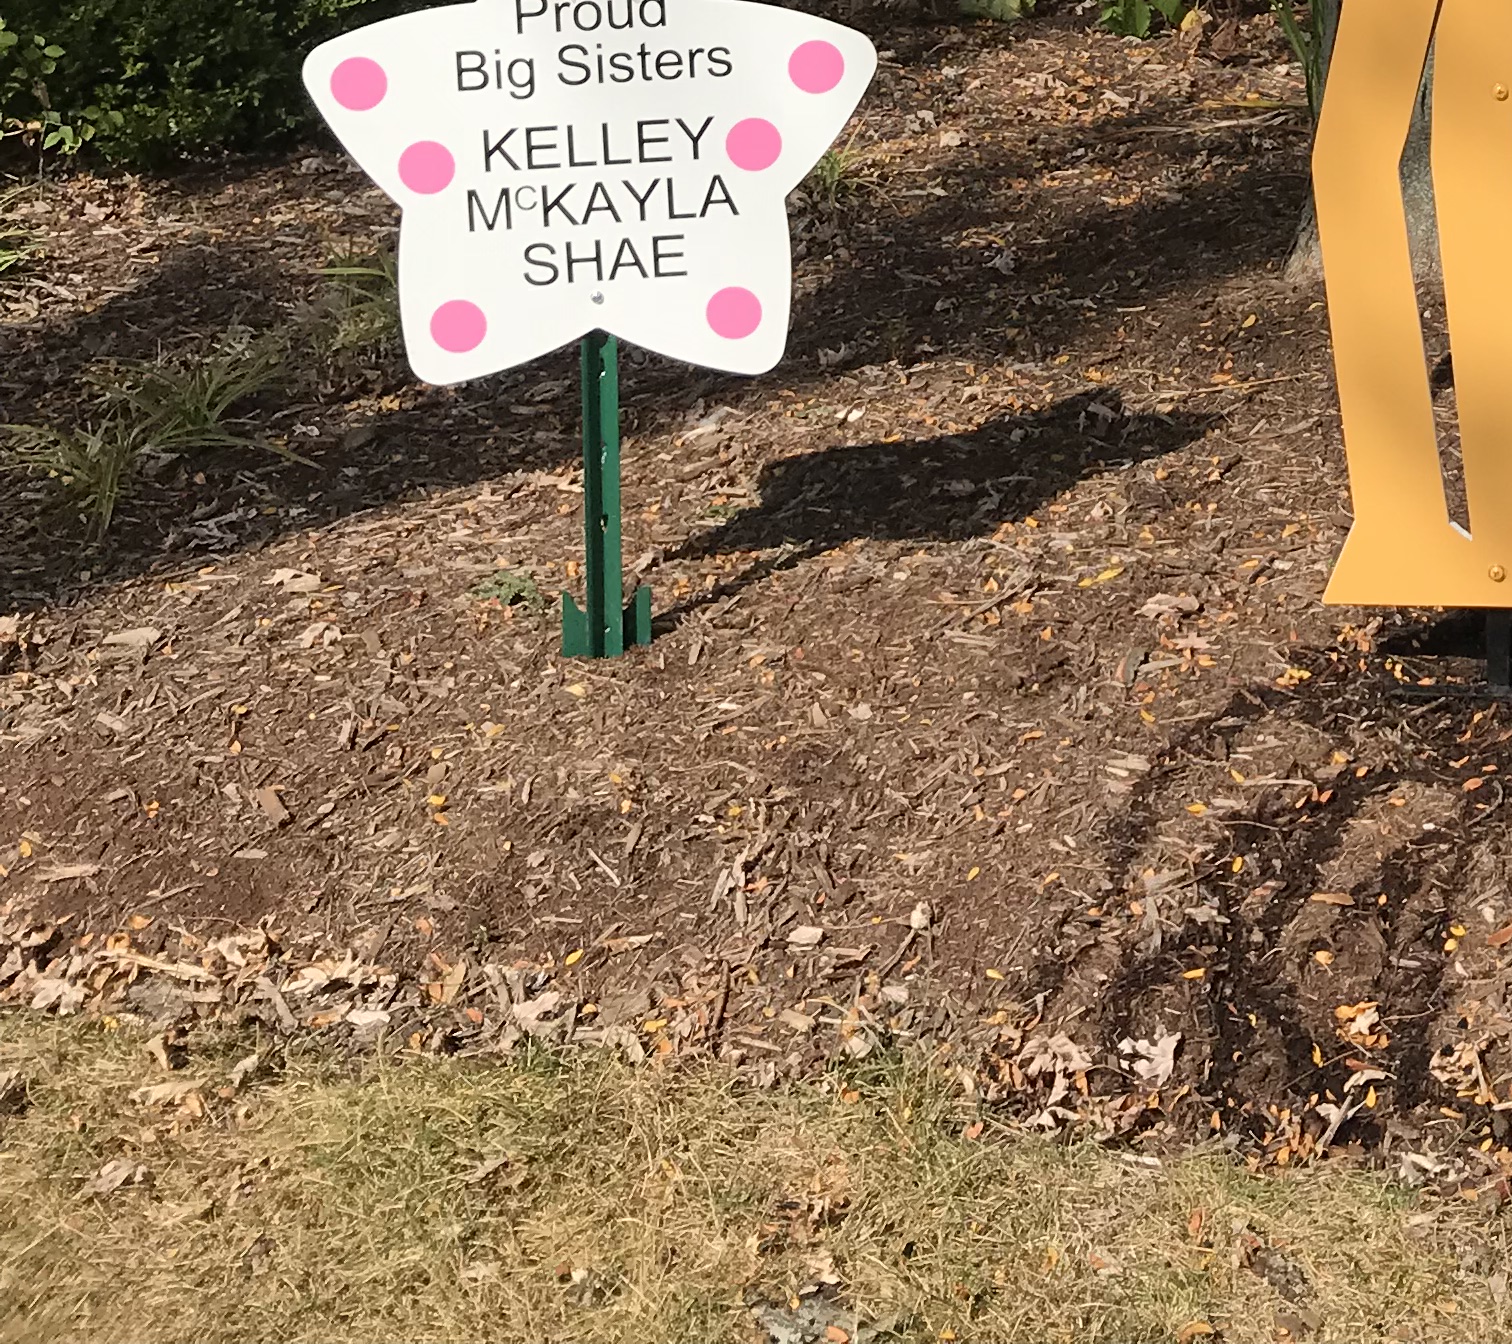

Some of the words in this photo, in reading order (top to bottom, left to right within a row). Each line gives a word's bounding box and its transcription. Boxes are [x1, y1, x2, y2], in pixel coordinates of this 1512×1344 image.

[456, 48, 535, 100] Big
[557, 42, 733, 86] Sisters
[483, 116, 714, 172] KELLEY
[524, 234, 688, 286] SHAE
